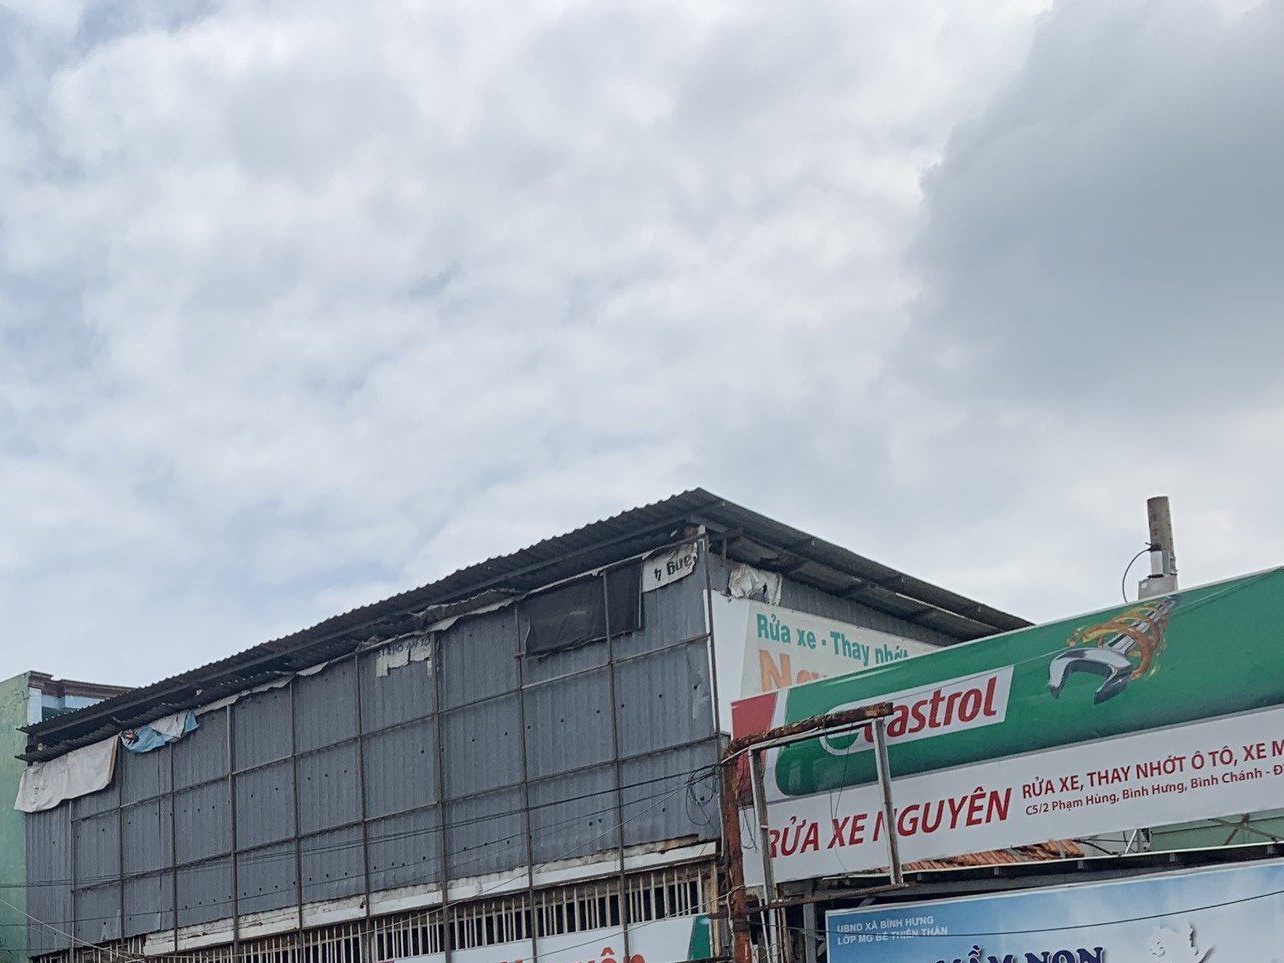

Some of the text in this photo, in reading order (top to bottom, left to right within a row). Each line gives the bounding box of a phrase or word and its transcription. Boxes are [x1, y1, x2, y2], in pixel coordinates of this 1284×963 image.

[757, 613, 791, 643] Rửa
[797, 628, 816, 649] xe
[830, 632, 869, 666] Thay
[864, 676, 998, 743] astrol
[1023, 777, 1055, 799] RỬA
[1059, 775, 1084, 793] XE,
[1087, 766, 1131, 787] THAY
[1136, 755, 1186, 779] NHỚT
[1191, 751, 1205, 770] Ô
[1209, 746, 1238, 767] TÔ,
[1243, 743, 1266, 761] XE
[1025, 803, 1049, 816] C5/2
[1051, 799, 1083, 812] Phạm
[1085, 793, 1120, 807] Hùng,
[1122, 785, 1149, 799] Bình
[1151, 781, 1187, 796] Hưng,
[1190, 775, 1219, 788] Bình
[1221, 768, 1262, 783] Chánh
[827, 813, 868, 849] XE
[837, 923, 863, 933] UBND
[880, 918, 903, 929] BÌNH
[905, 916, 934, 926] HƯNG
[858, 934, 874, 943] MG
